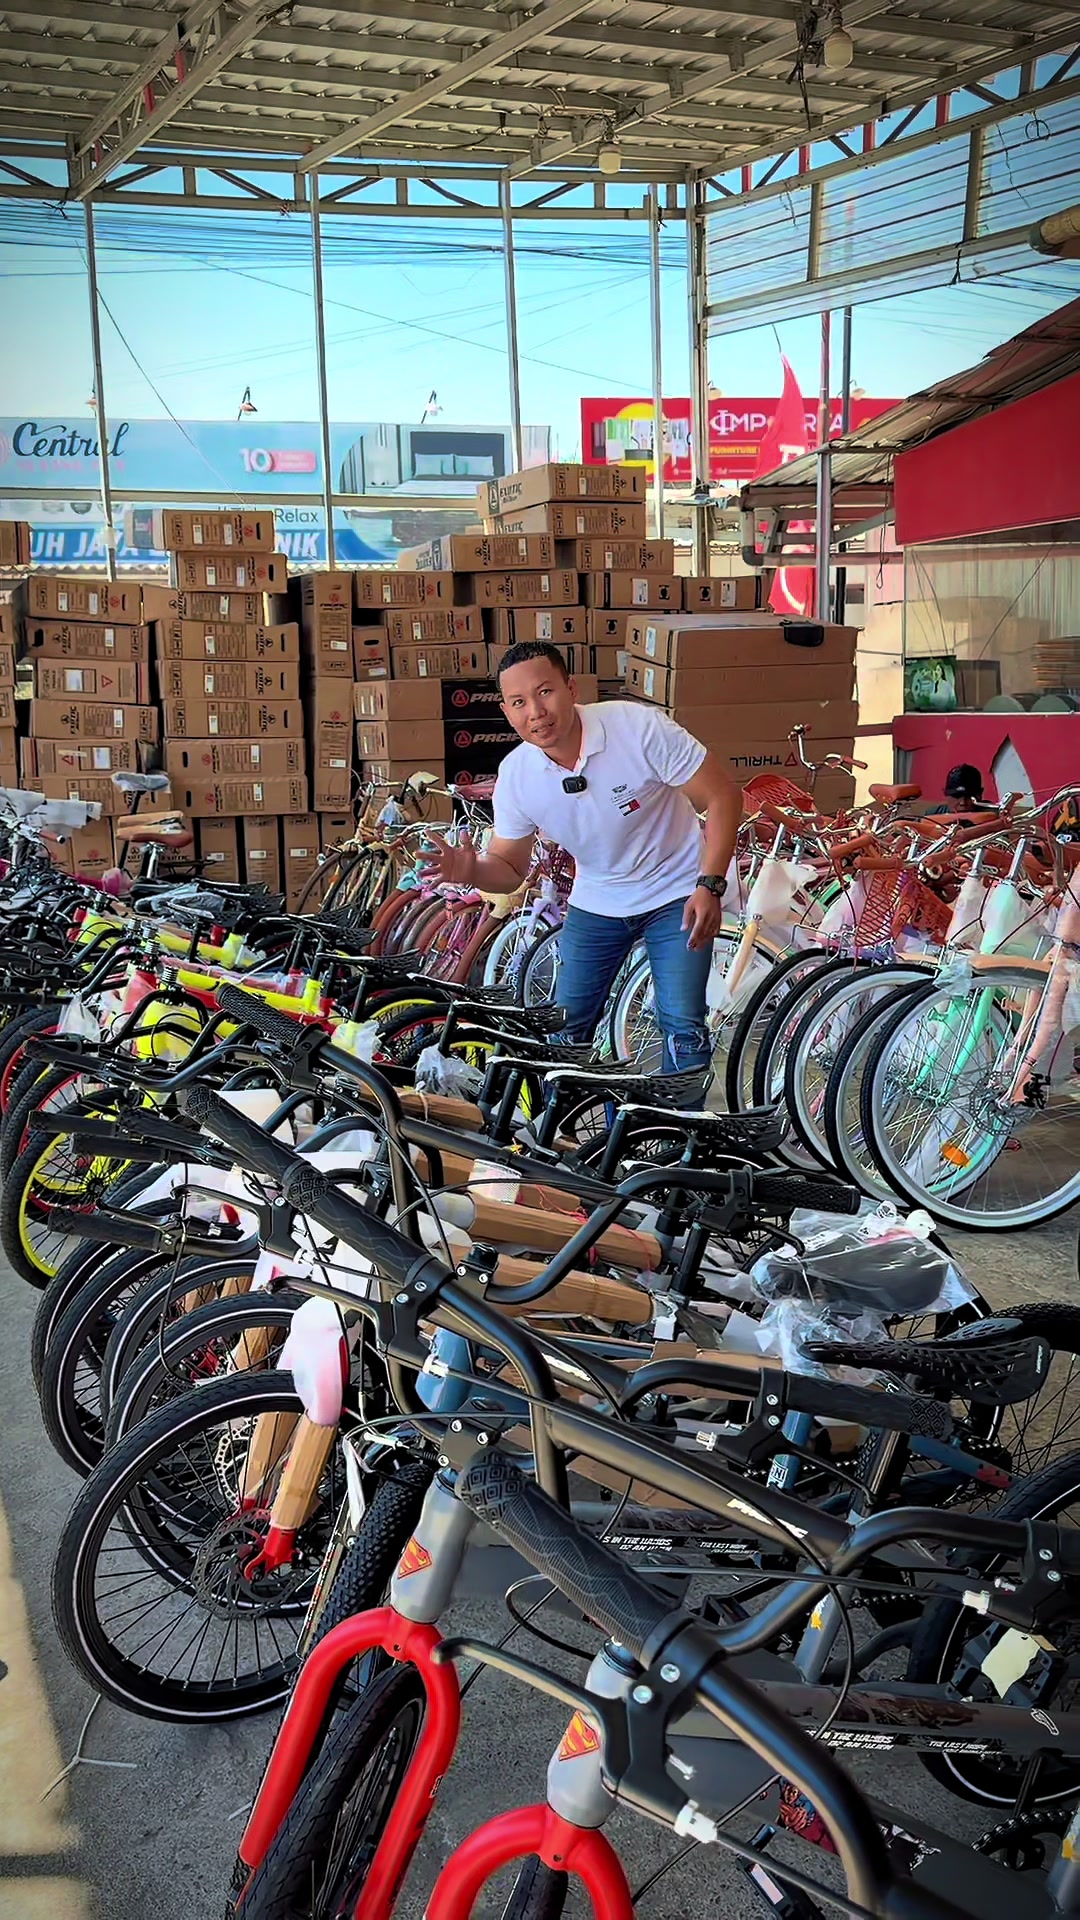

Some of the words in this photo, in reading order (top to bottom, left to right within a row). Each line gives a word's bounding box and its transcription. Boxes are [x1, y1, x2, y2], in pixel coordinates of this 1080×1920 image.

[239, 447, 274, 473] 10
[275, 508, 319, 523] Relax
[729, 755, 783, 768] THRILL
[623, 1537, 641, 1545] THE
[832, 1732, 854, 1741] THE
